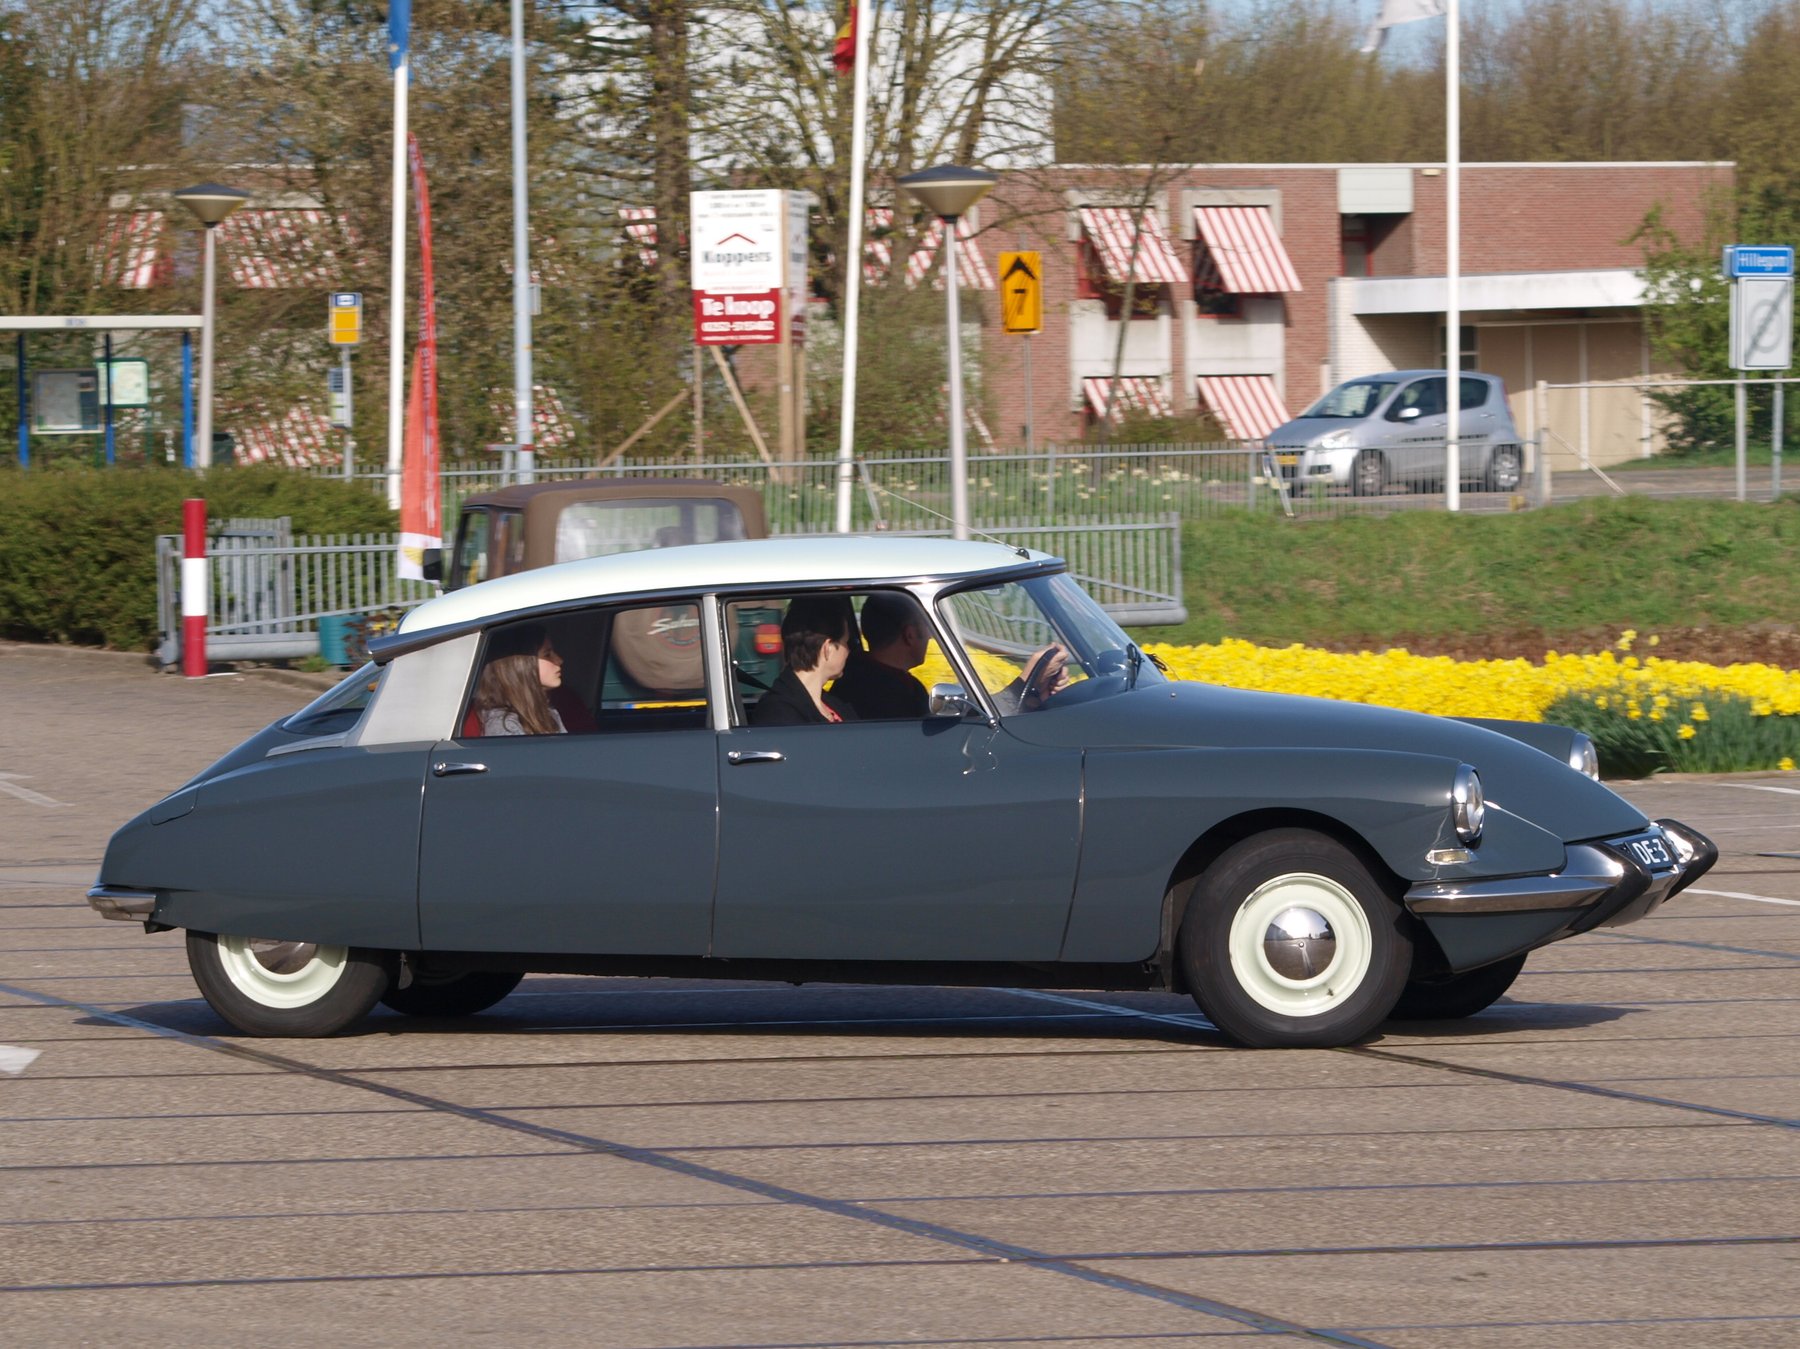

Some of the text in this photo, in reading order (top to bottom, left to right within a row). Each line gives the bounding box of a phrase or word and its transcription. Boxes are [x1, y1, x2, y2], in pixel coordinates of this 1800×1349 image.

[702, 251, 772, 267] Koppers
[700, 296, 776, 319] Te koop
